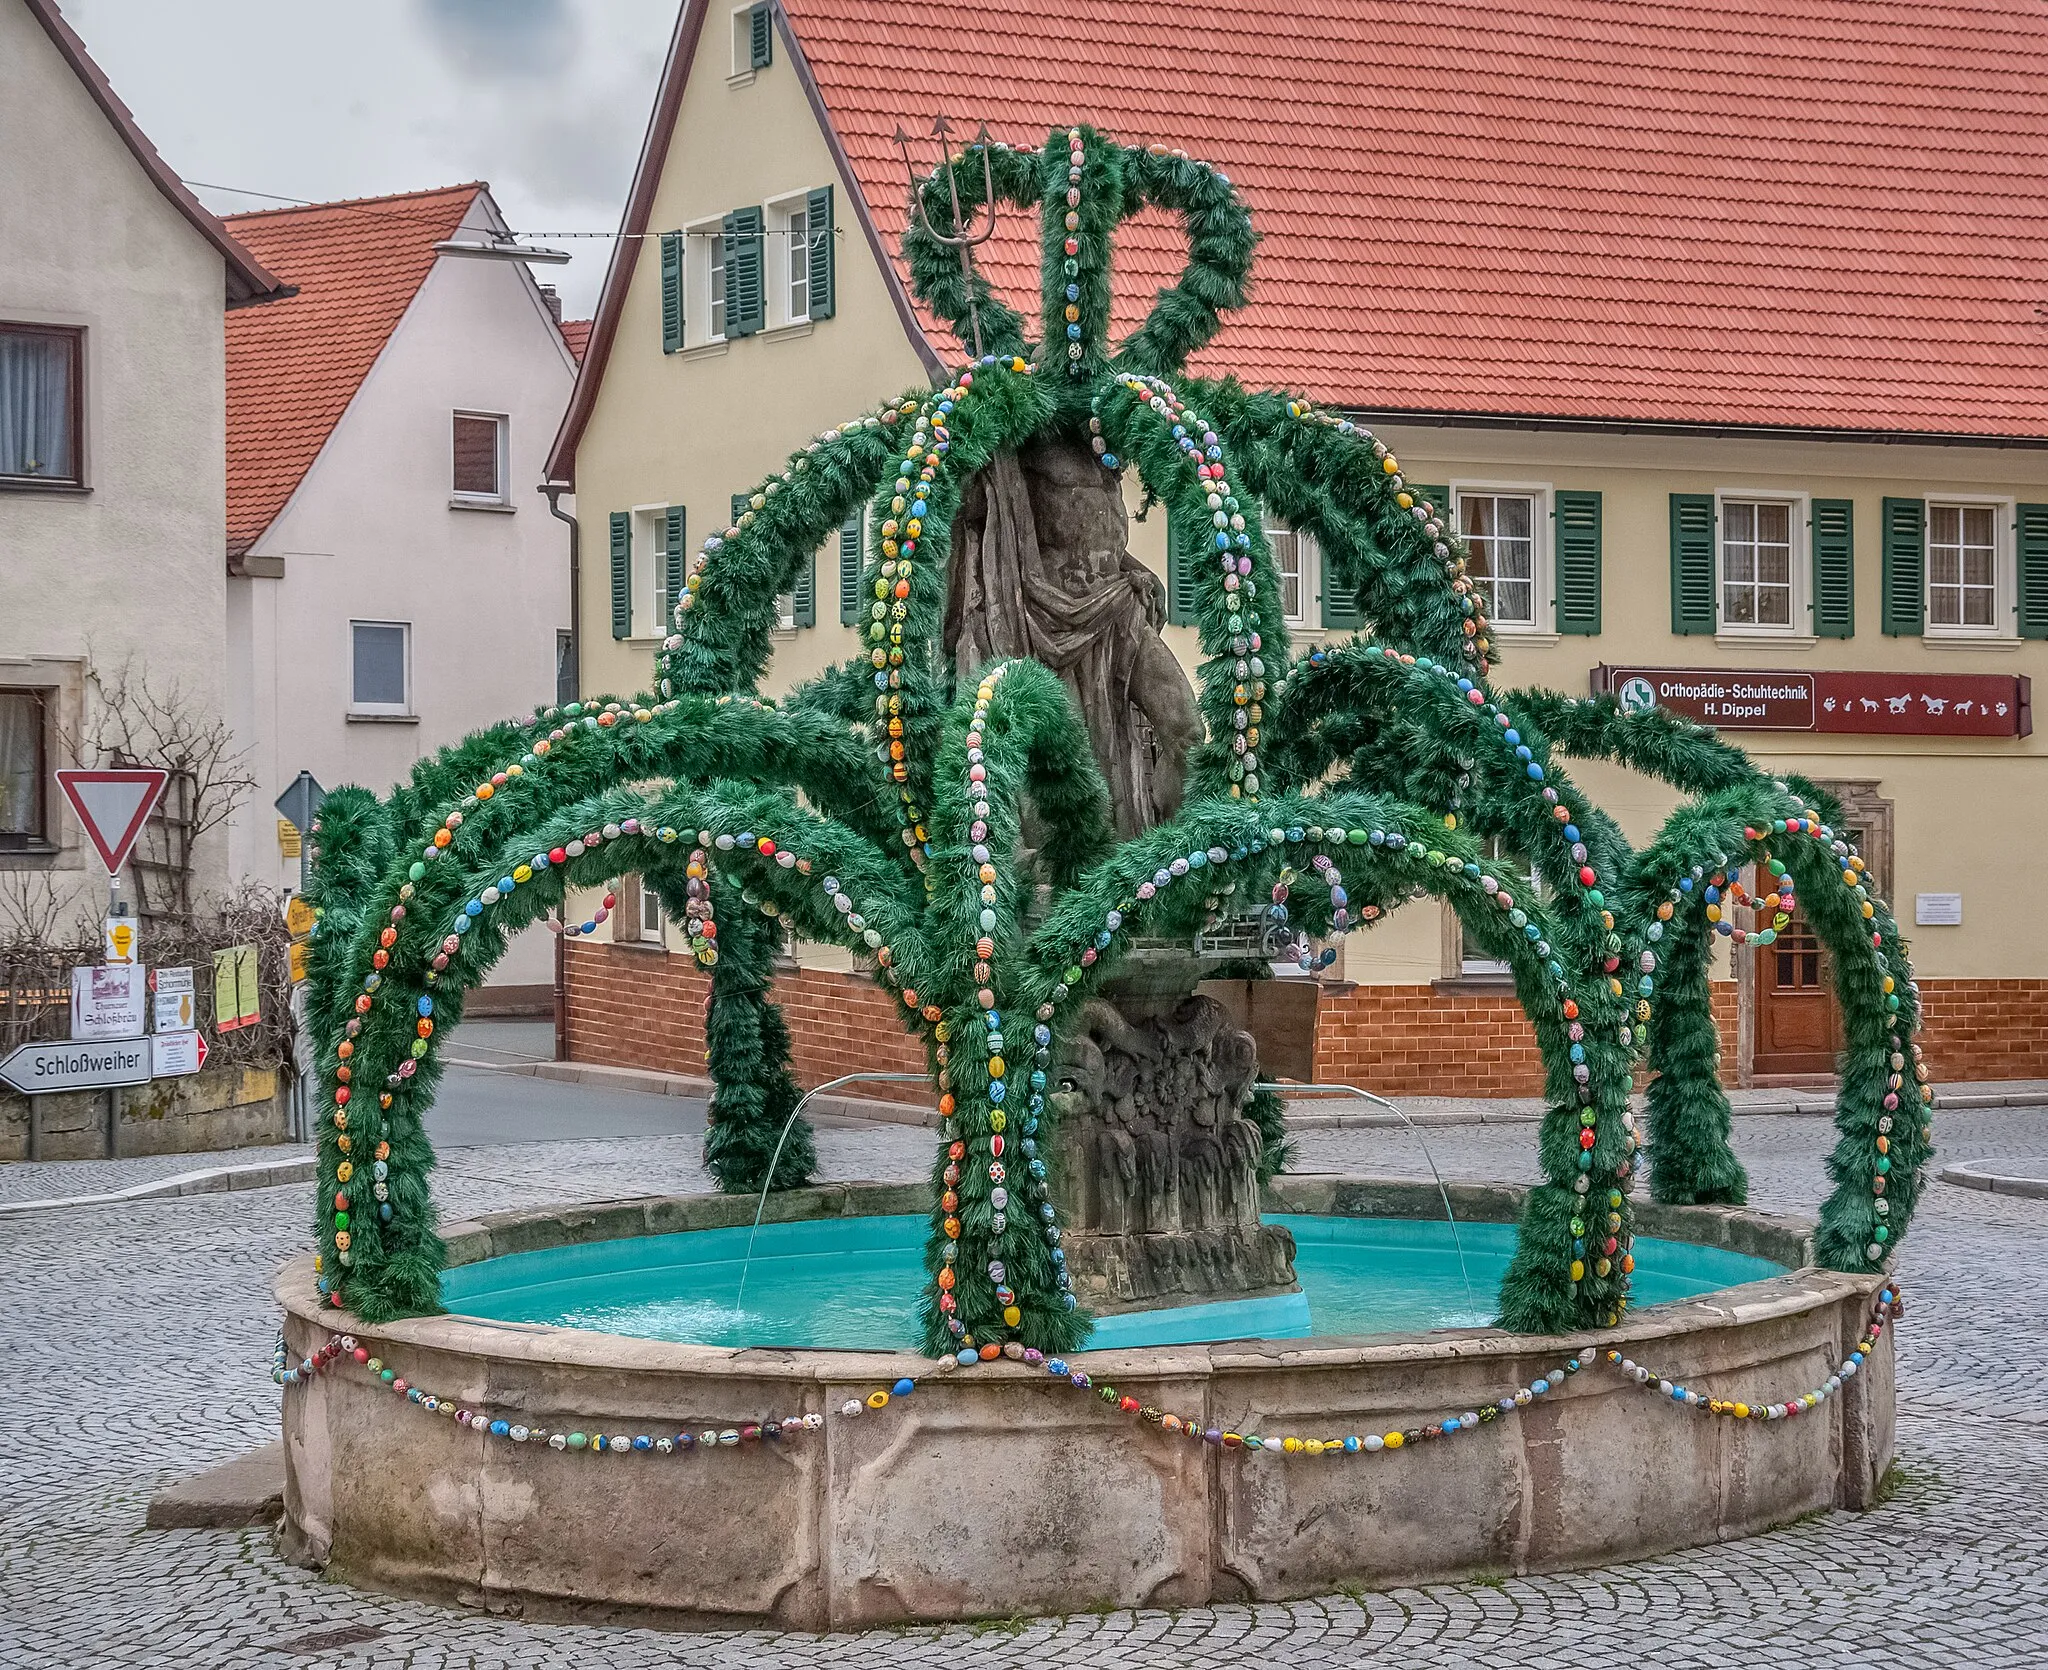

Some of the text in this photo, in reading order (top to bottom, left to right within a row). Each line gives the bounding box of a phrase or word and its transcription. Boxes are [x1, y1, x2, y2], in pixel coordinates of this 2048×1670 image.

[1660, 682, 1808, 700] Orthopädie-Schuhtechnik
[1704, 703, 1766, 718] H. Dippel
[85, 1011, 137, 1026] Schloßbräu
[34, 1050, 140, 1076] Schloßweiher
